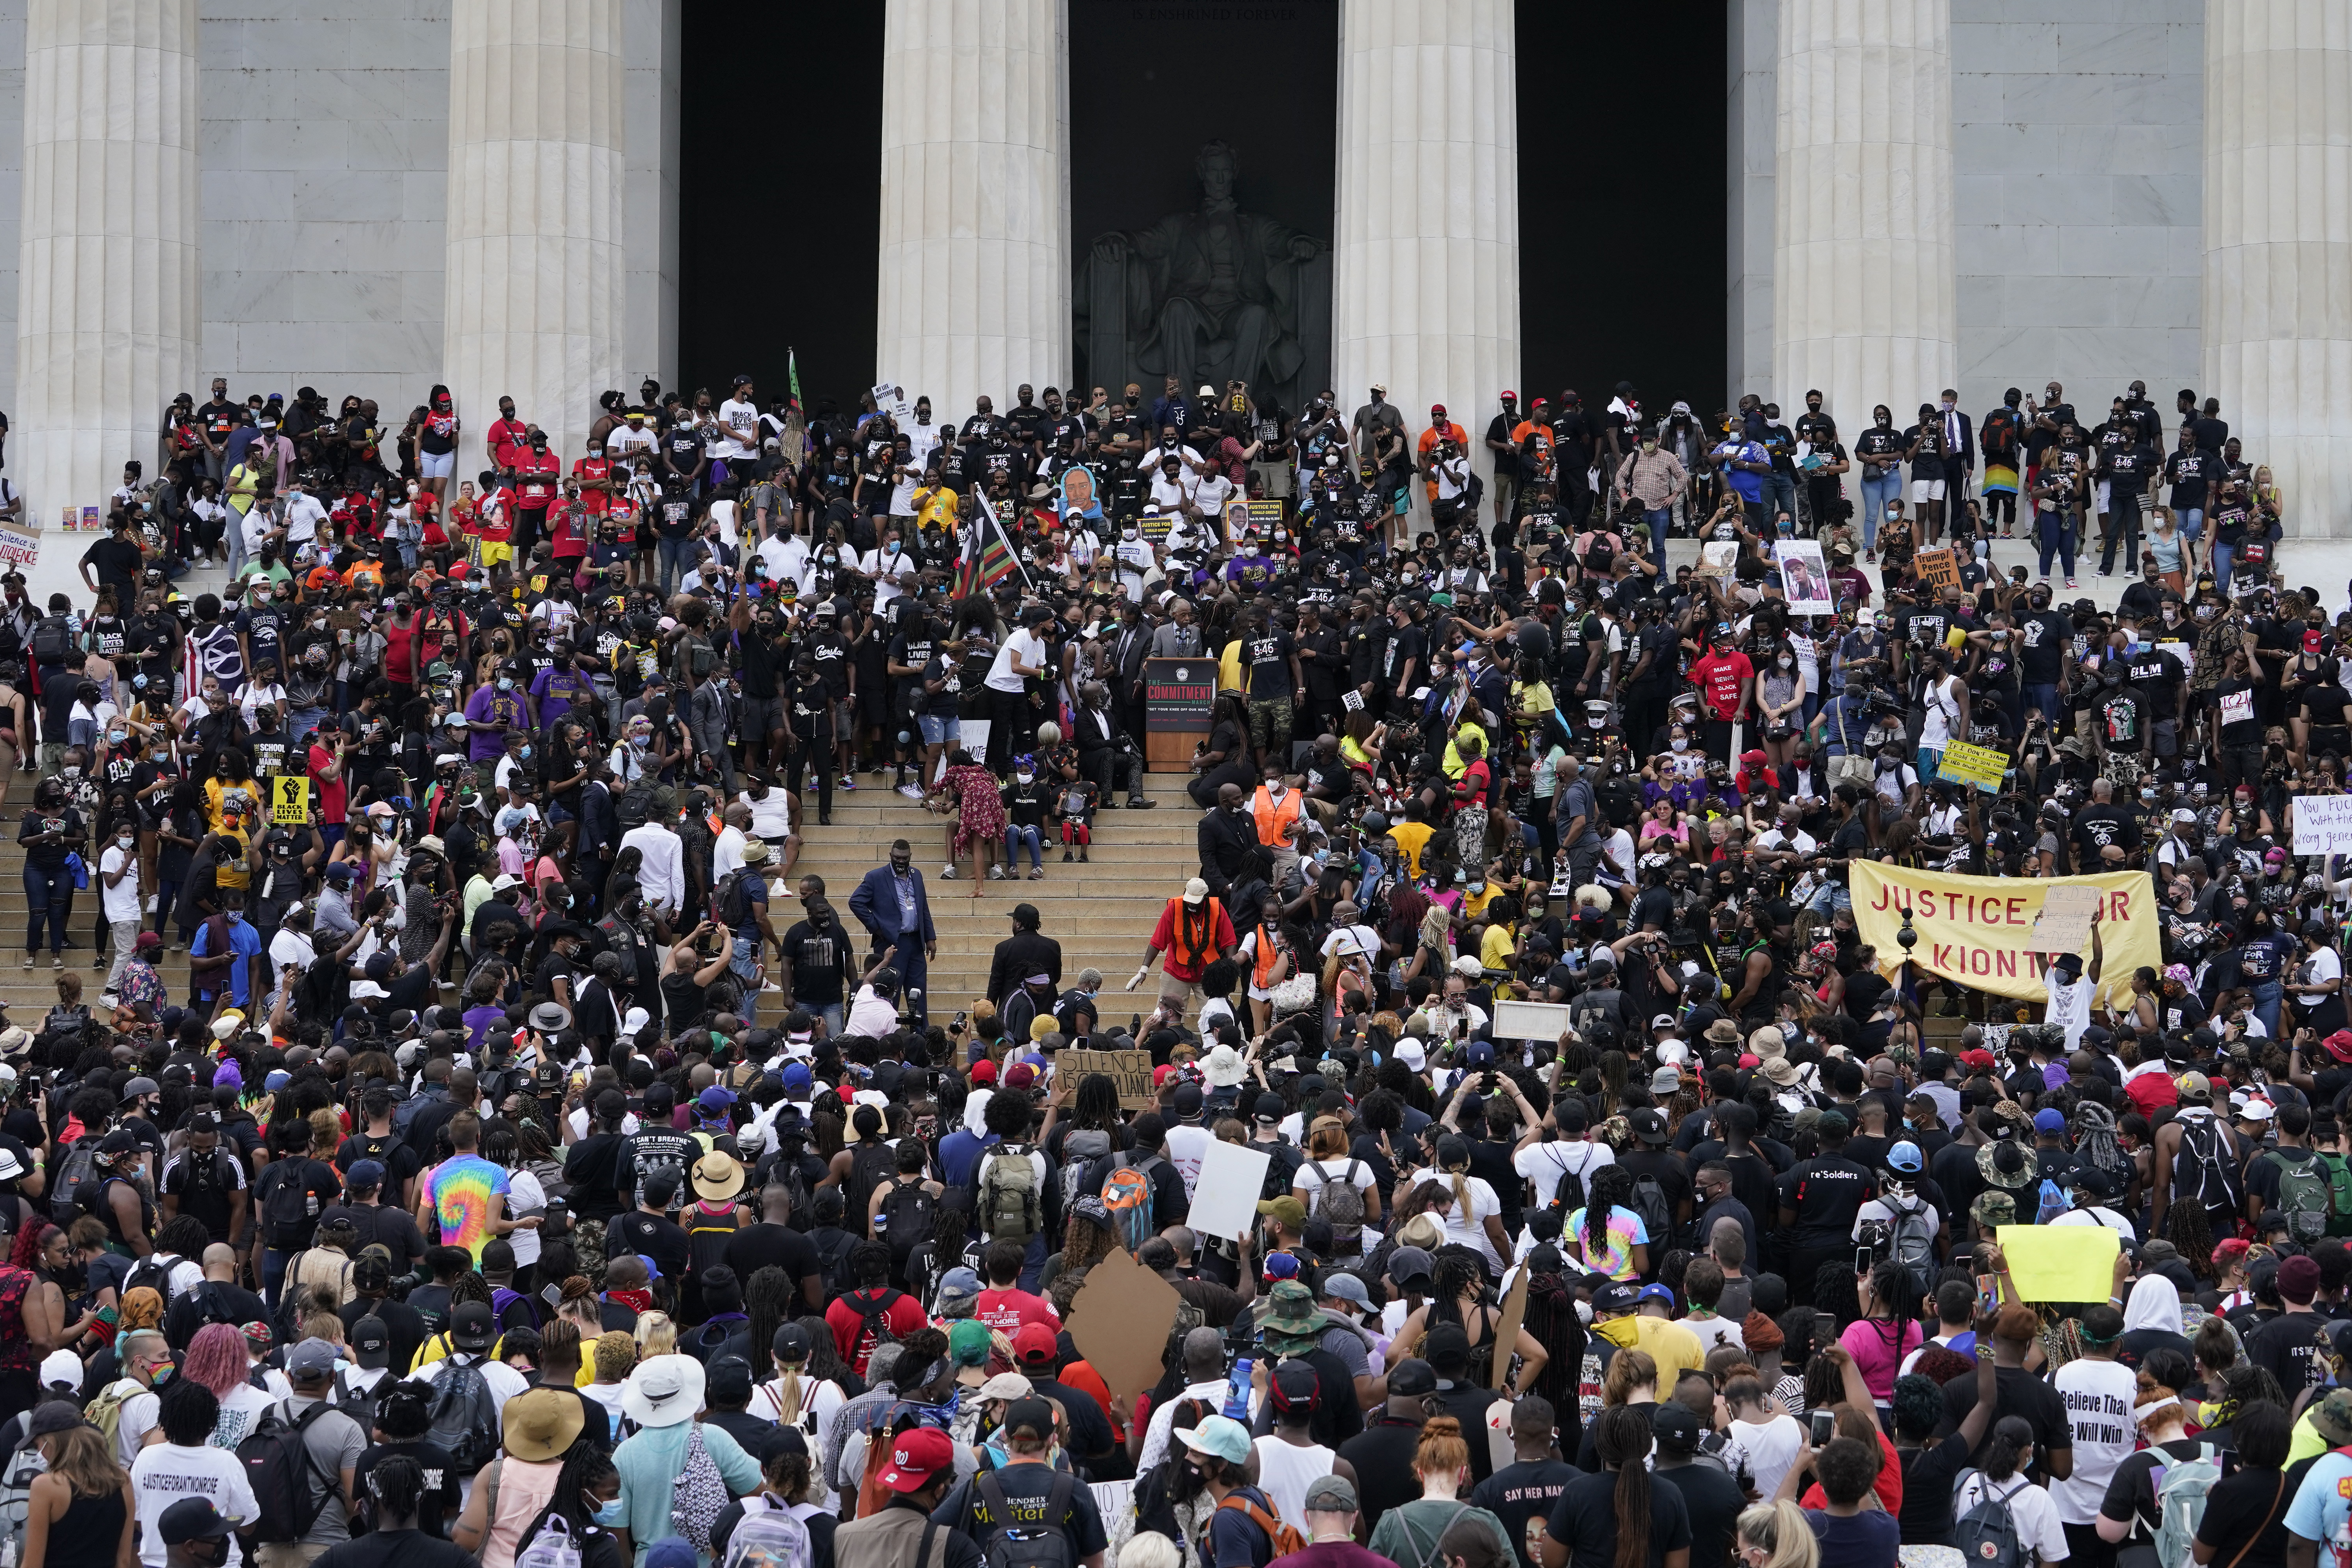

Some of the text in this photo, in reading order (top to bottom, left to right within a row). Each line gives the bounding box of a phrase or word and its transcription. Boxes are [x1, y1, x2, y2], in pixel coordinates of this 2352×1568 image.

[1133, 9, 1297, 20] IS ENSHRINED FOREVER
[875, 389, 894, 401] MATTERED
[990, 458, 1007, 466] 8:46
[2115, 458, 2132, 467] 8:46
[1536, 517, 1553, 525] 8:46
[1338, 524, 1356, 536] 8:46
[29, 540, 36, 549] is
[1917, 550, 1949, 563] Trump/
[1922, 561, 1950, 572] Pence
[1926, 570, 1951, 586] OUT
[1311, 592, 1327, 602] 8:46
[503, 612, 521, 621] GOOD
[506, 619, 523, 628] Trouble
[597, 635, 623, 645] BLACK
[907, 641, 931, 651] BLACK
[1254, 642, 1274, 656] 8:46
[532, 658, 554, 666] BLACK
[1713, 665, 1732, 673] MAKE
[2131, 663, 2161, 677] BLM
[1714, 675, 1735, 683] BEING
[1147, 686, 1212, 699] COMMITMENT
[1975, 724, 1998, 735] BLACK
[260, 743, 285, 753] SCHOOL
[1953, 752, 1968, 761] TODAY
[256, 765, 265, 777] OF
[2299, 796, 2352, 816] You Fuc
[1871, 883, 2027, 925] JUSTICE
[1062, 1051, 1151, 1074] SILENCE
[1063, 1073, 1077, 1090] IS
[425, 1308, 441, 1317] Names
[2291, 1346, 2314, 1357] IT'S THE
[2060, 1390, 2101, 1412] Believe
[2077, 1421, 2122, 1444] Will Win
[895, 1450, 909, 1465] W
[143, 1473, 218, 1494] #JUSTICEFORANTWONROSE
[1505, 1485, 1564, 1502] SAY HER NAM
